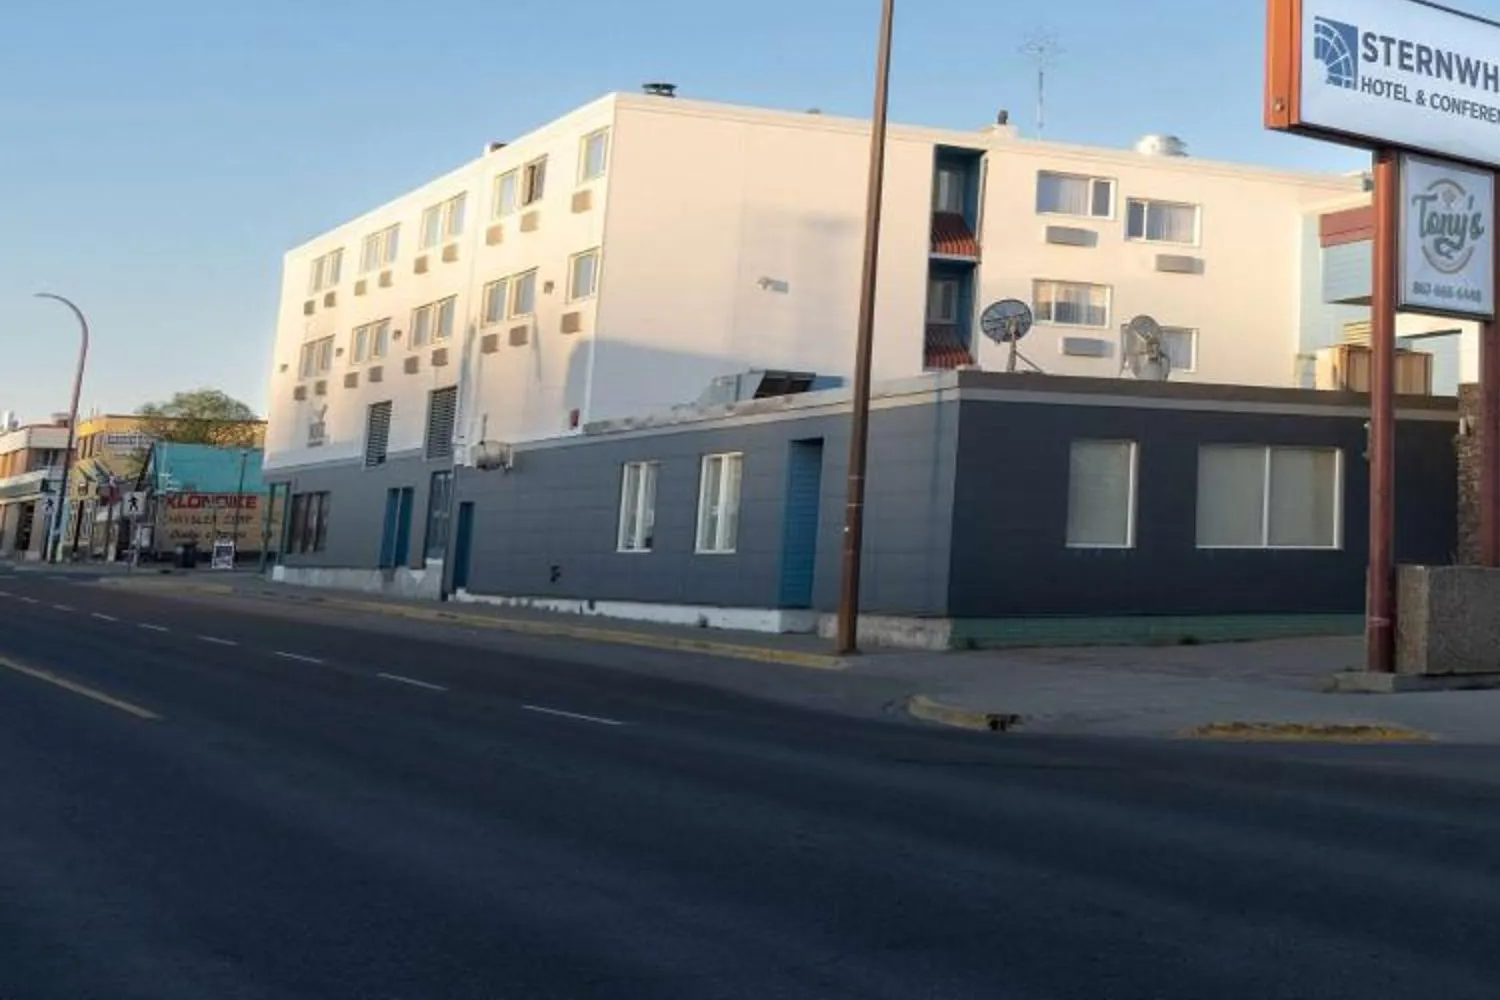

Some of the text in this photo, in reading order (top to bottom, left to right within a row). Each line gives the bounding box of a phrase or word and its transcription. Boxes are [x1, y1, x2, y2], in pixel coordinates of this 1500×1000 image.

[1361, 75, 1412, 103] HOTEL
[1415, 89, 1427, 107] &
[1411, 193, 1485, 260] Tony's
